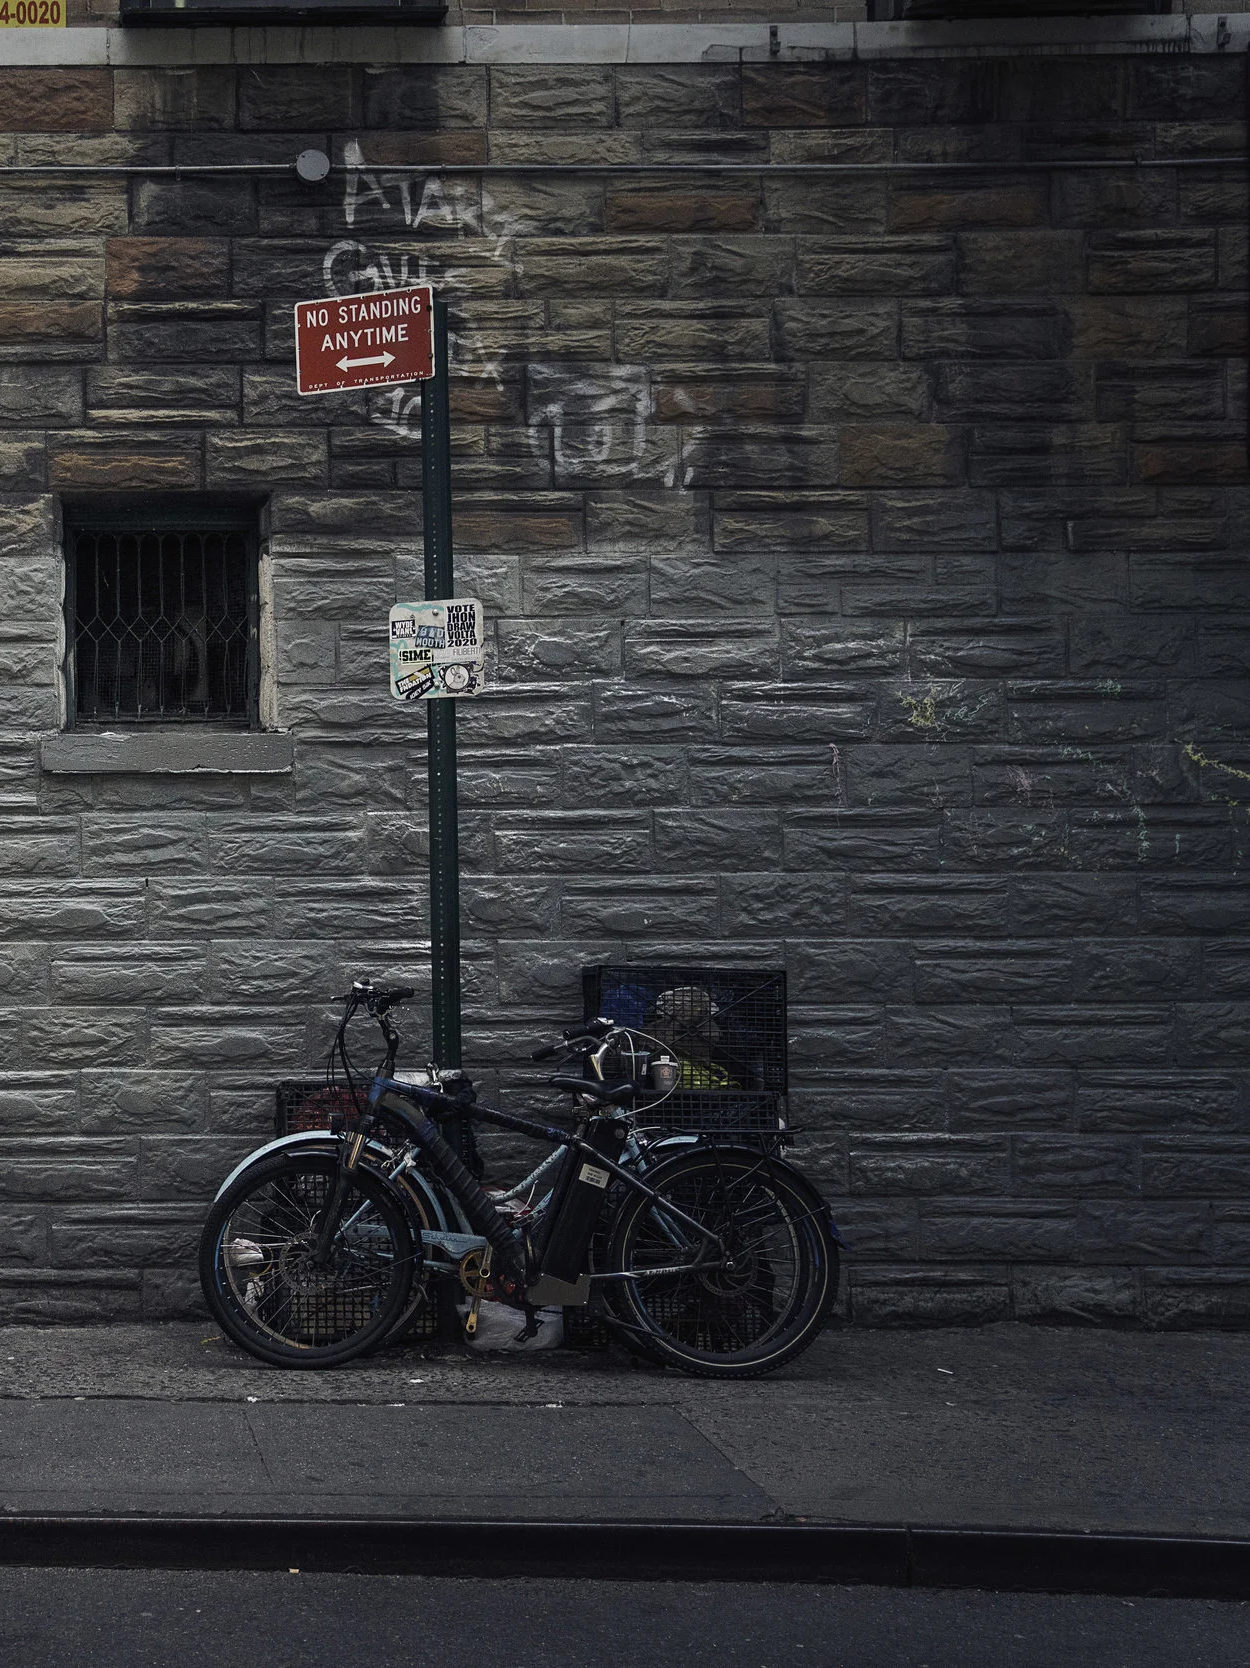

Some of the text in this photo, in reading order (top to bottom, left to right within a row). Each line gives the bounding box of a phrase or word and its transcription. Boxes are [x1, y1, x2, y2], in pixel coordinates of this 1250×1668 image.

[306, 296, 421, 329] NO STANDING
[321, 323, 410, 352] ANYTIME
[308, 382, 329, 390] DEPT
[353, 370, 425, 384] TRANSPORTATION
[447, 604, 475, 613] VOTE
[447, 612, 476, 623] JHON
[447, 621, 476, 632] DRAW
[448, 629, 476, 640] VOLTA
[416, 637, 445, 648] MOUTH
[447, 638, 477, 648] 2020
